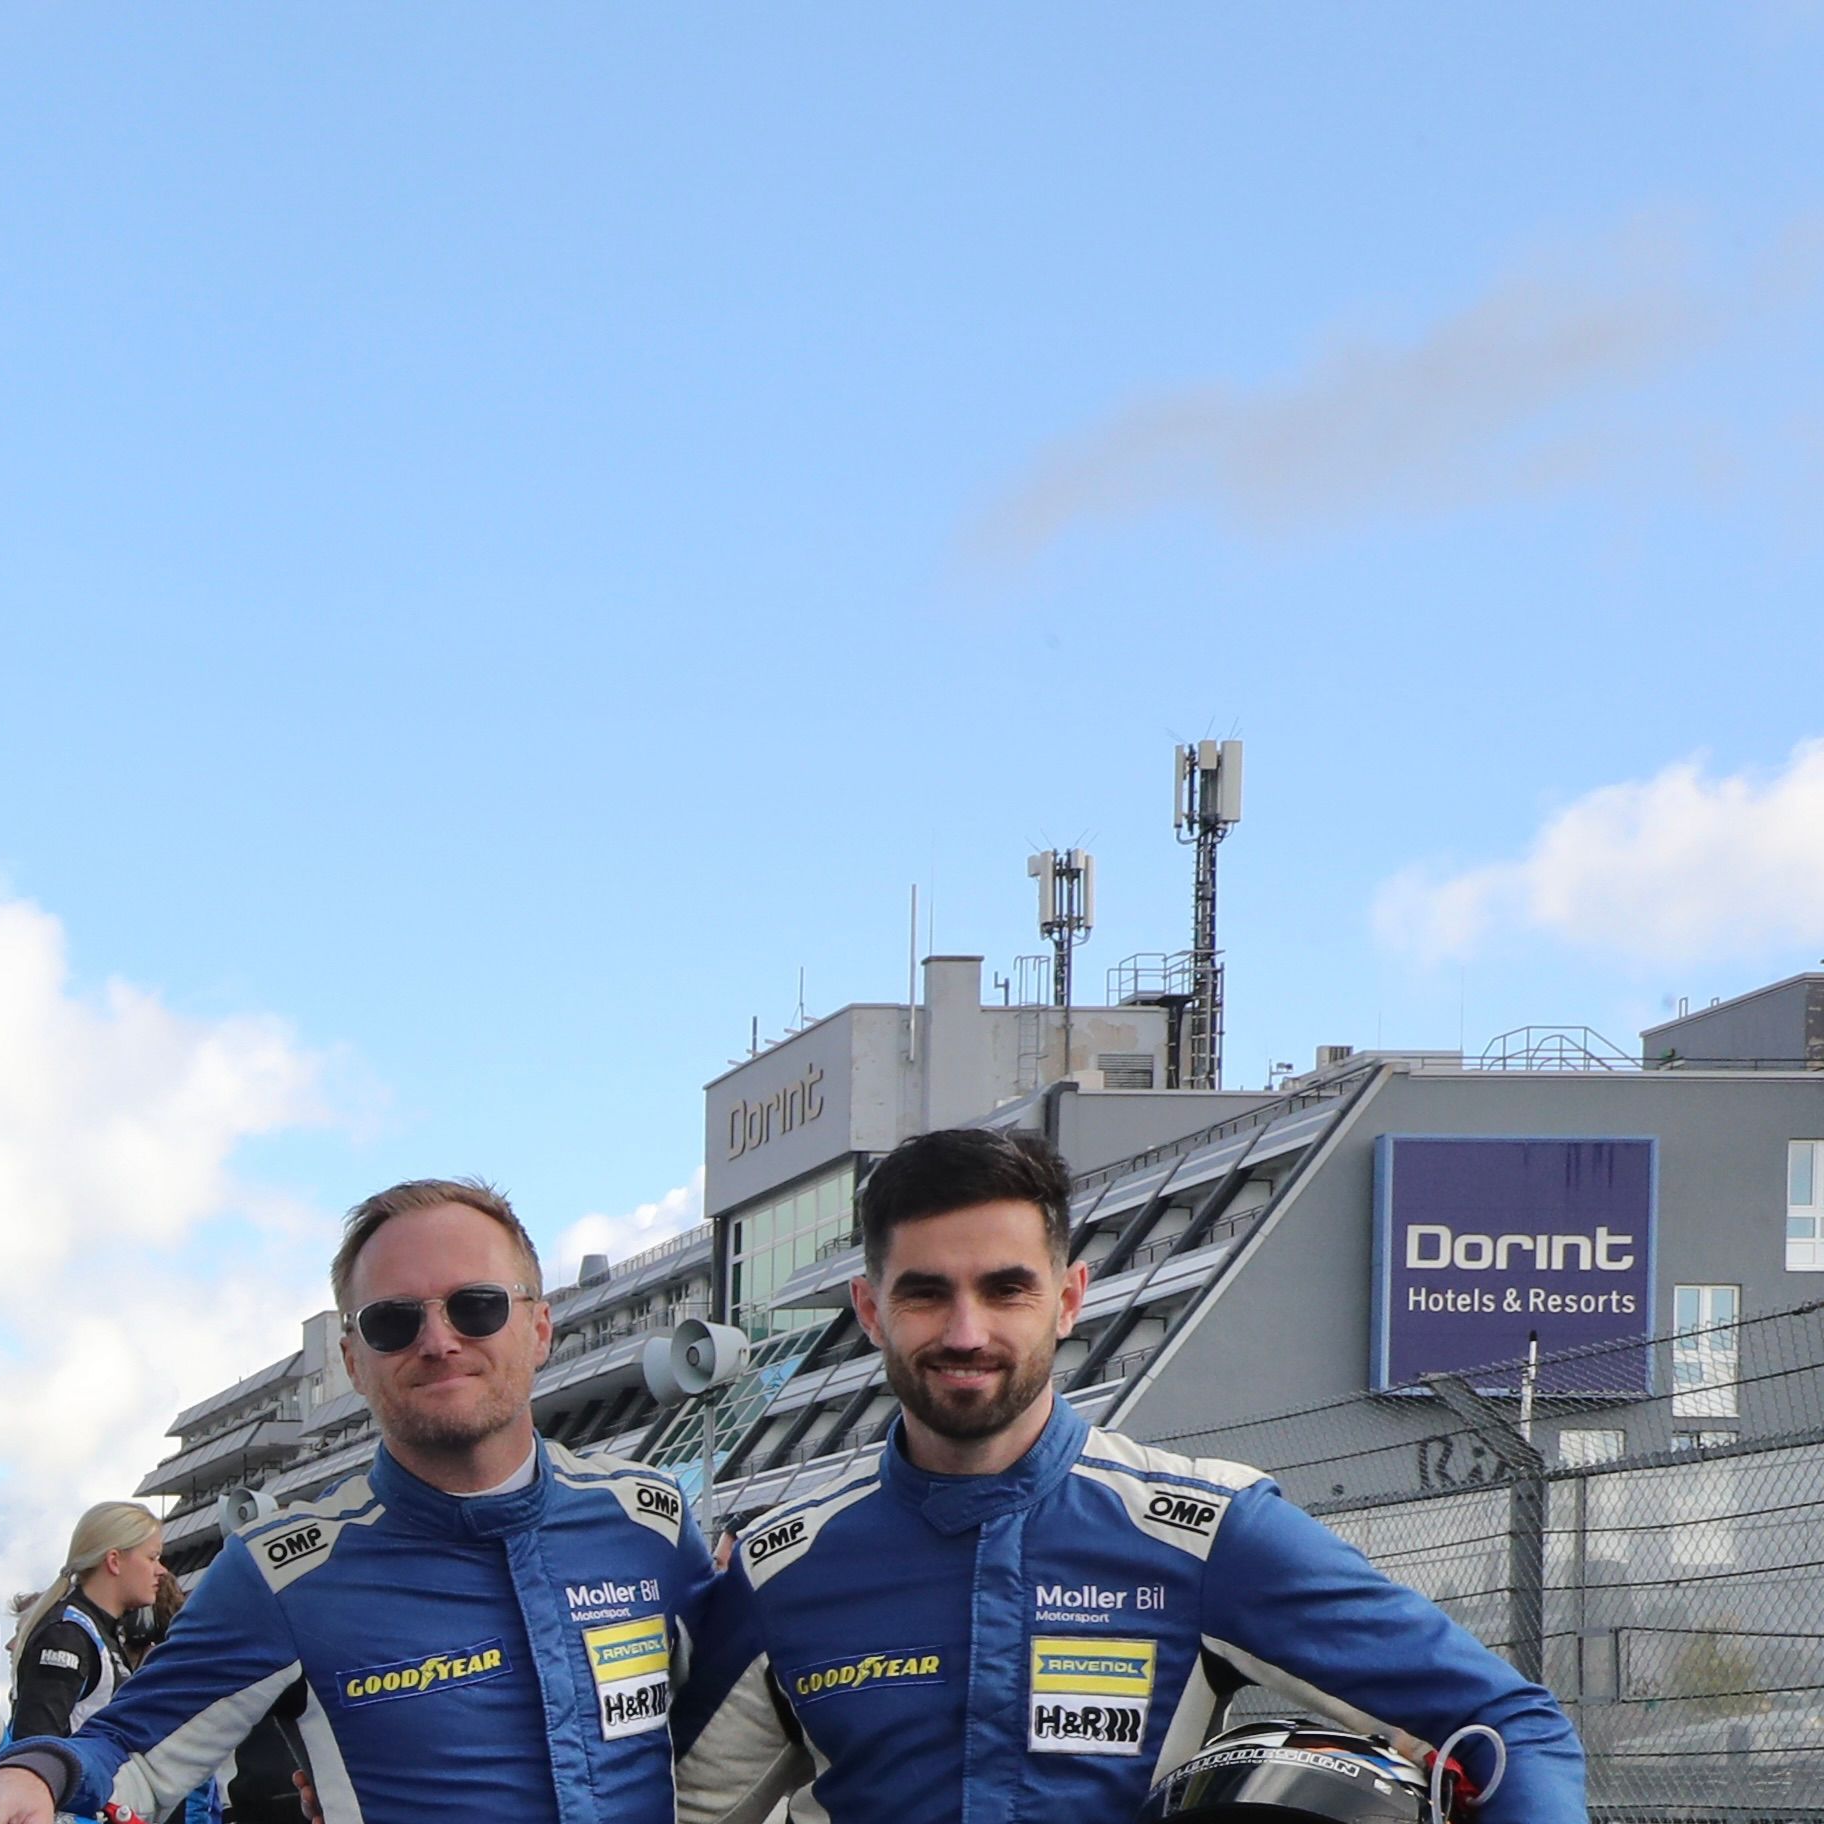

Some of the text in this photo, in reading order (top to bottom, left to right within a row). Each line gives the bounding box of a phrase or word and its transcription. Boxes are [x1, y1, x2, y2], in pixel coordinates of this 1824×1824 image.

[727, 1061, 825, 1161] Dorint
[1406, 1225, 1635, 1271] Dorint
[1408, 1286, 1636, 1315] Hotels & Resorts
[636, 1488, 680, 1518] OMP
[1149, 1496, 1216, 1527] OMP
[267, 1527, 322, 1563] OMP
[749, 1521, 804, 1558] OMP
[640, 1579, 660, 1602] Bil
[1136, 1584, 1165, 1610] Bil
[570, 1607, 632, 1623] Motorsport
[1035, 1611, 1110, 1624] Motorsport
[601, 1638, 663, 1661] RAVENOL
[346, 1648, 502, 1697] GOODYEAR
[796, 1655, 940, 1695] GOODYEAR
[1048, 1658, 1139, 1674] RAVENOL
[604, 1685, 652, 1726] H&R
[1036, 1705, 1105, 1741] H&R
